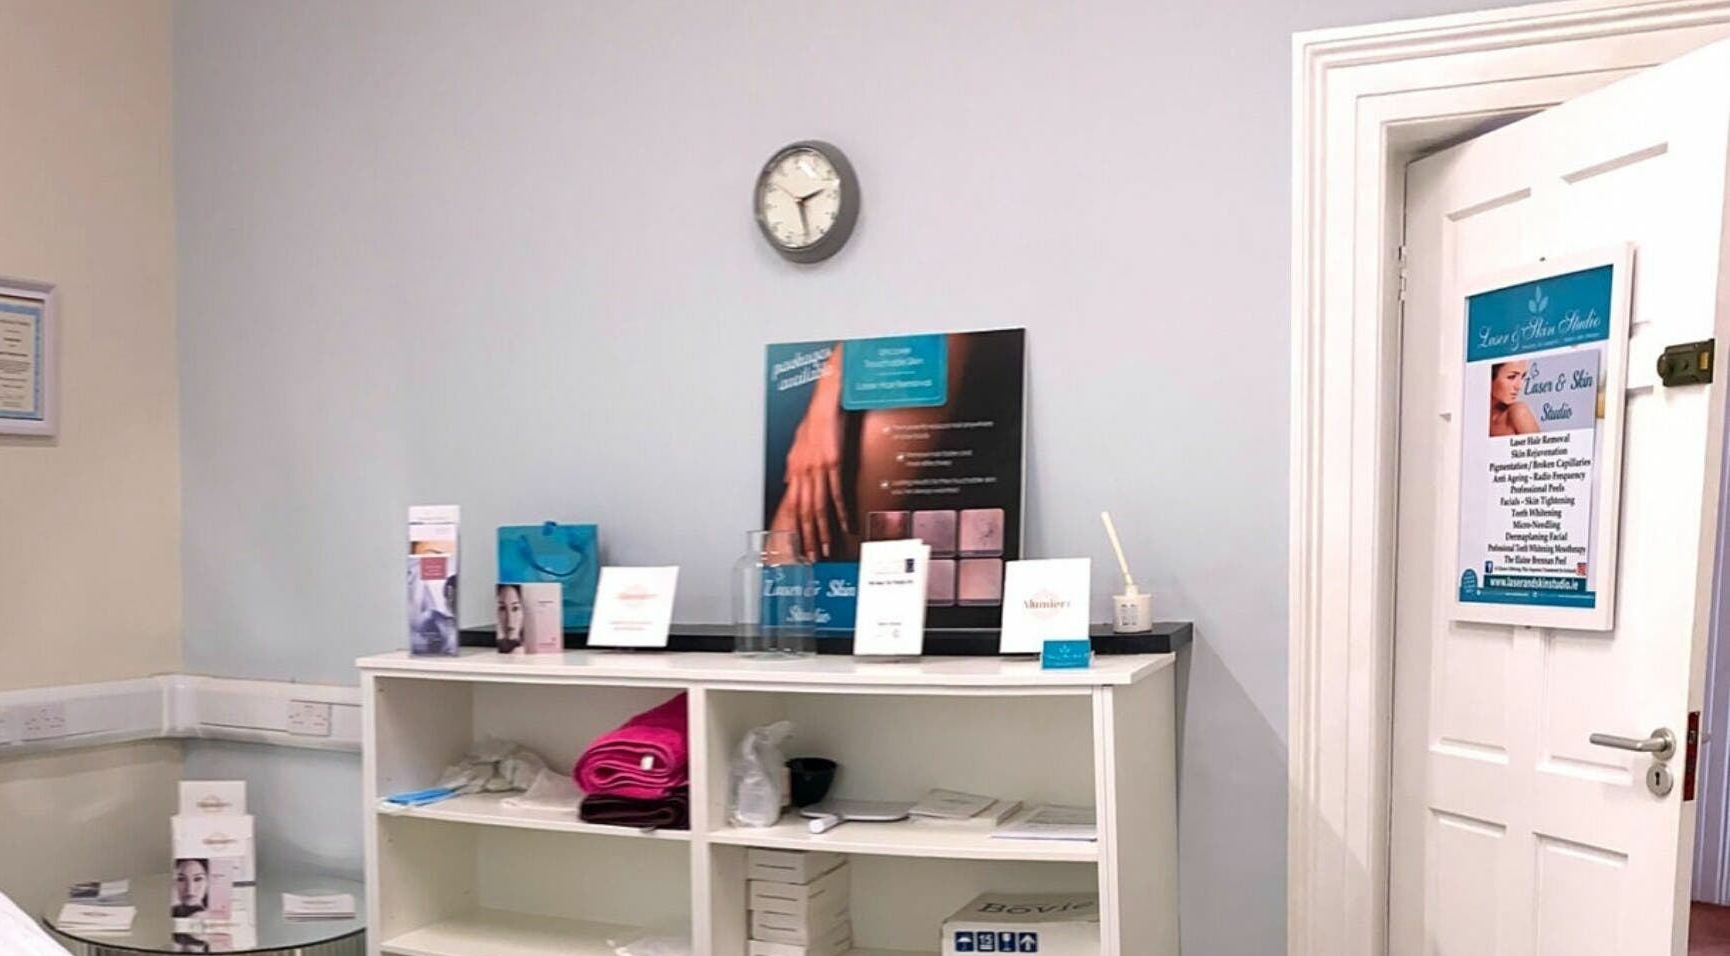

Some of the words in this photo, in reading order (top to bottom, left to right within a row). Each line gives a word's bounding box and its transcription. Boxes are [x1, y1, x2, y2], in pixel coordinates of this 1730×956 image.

[1479, 326, 1509, 348] Laser
[1521, 317, 1555, 340] Skin
[1558, 308, 1601, 333] Studio
[1524, 377, 1553, 395] Laser
[1555, 372, 1567, 392] &
[1570, 369, 1593, 390] Skin
[1541, 402, 1573, 422] Studio
[1510, 438, 1526, 446] Laser
[1527, 436, 1541, 445] Hair
[1542, 433, 1571, 444] Removal
[1511, 449, 1525, 458] Skin
[1556, 458, 1591, 470] Capillaries
[1533, 472, 1551, 481] Radio
[1552, 472, 1585, 482] Frequency
[1525, 496, 1539, 505] Skin
[977, 901, 1095, 915] Bovie
